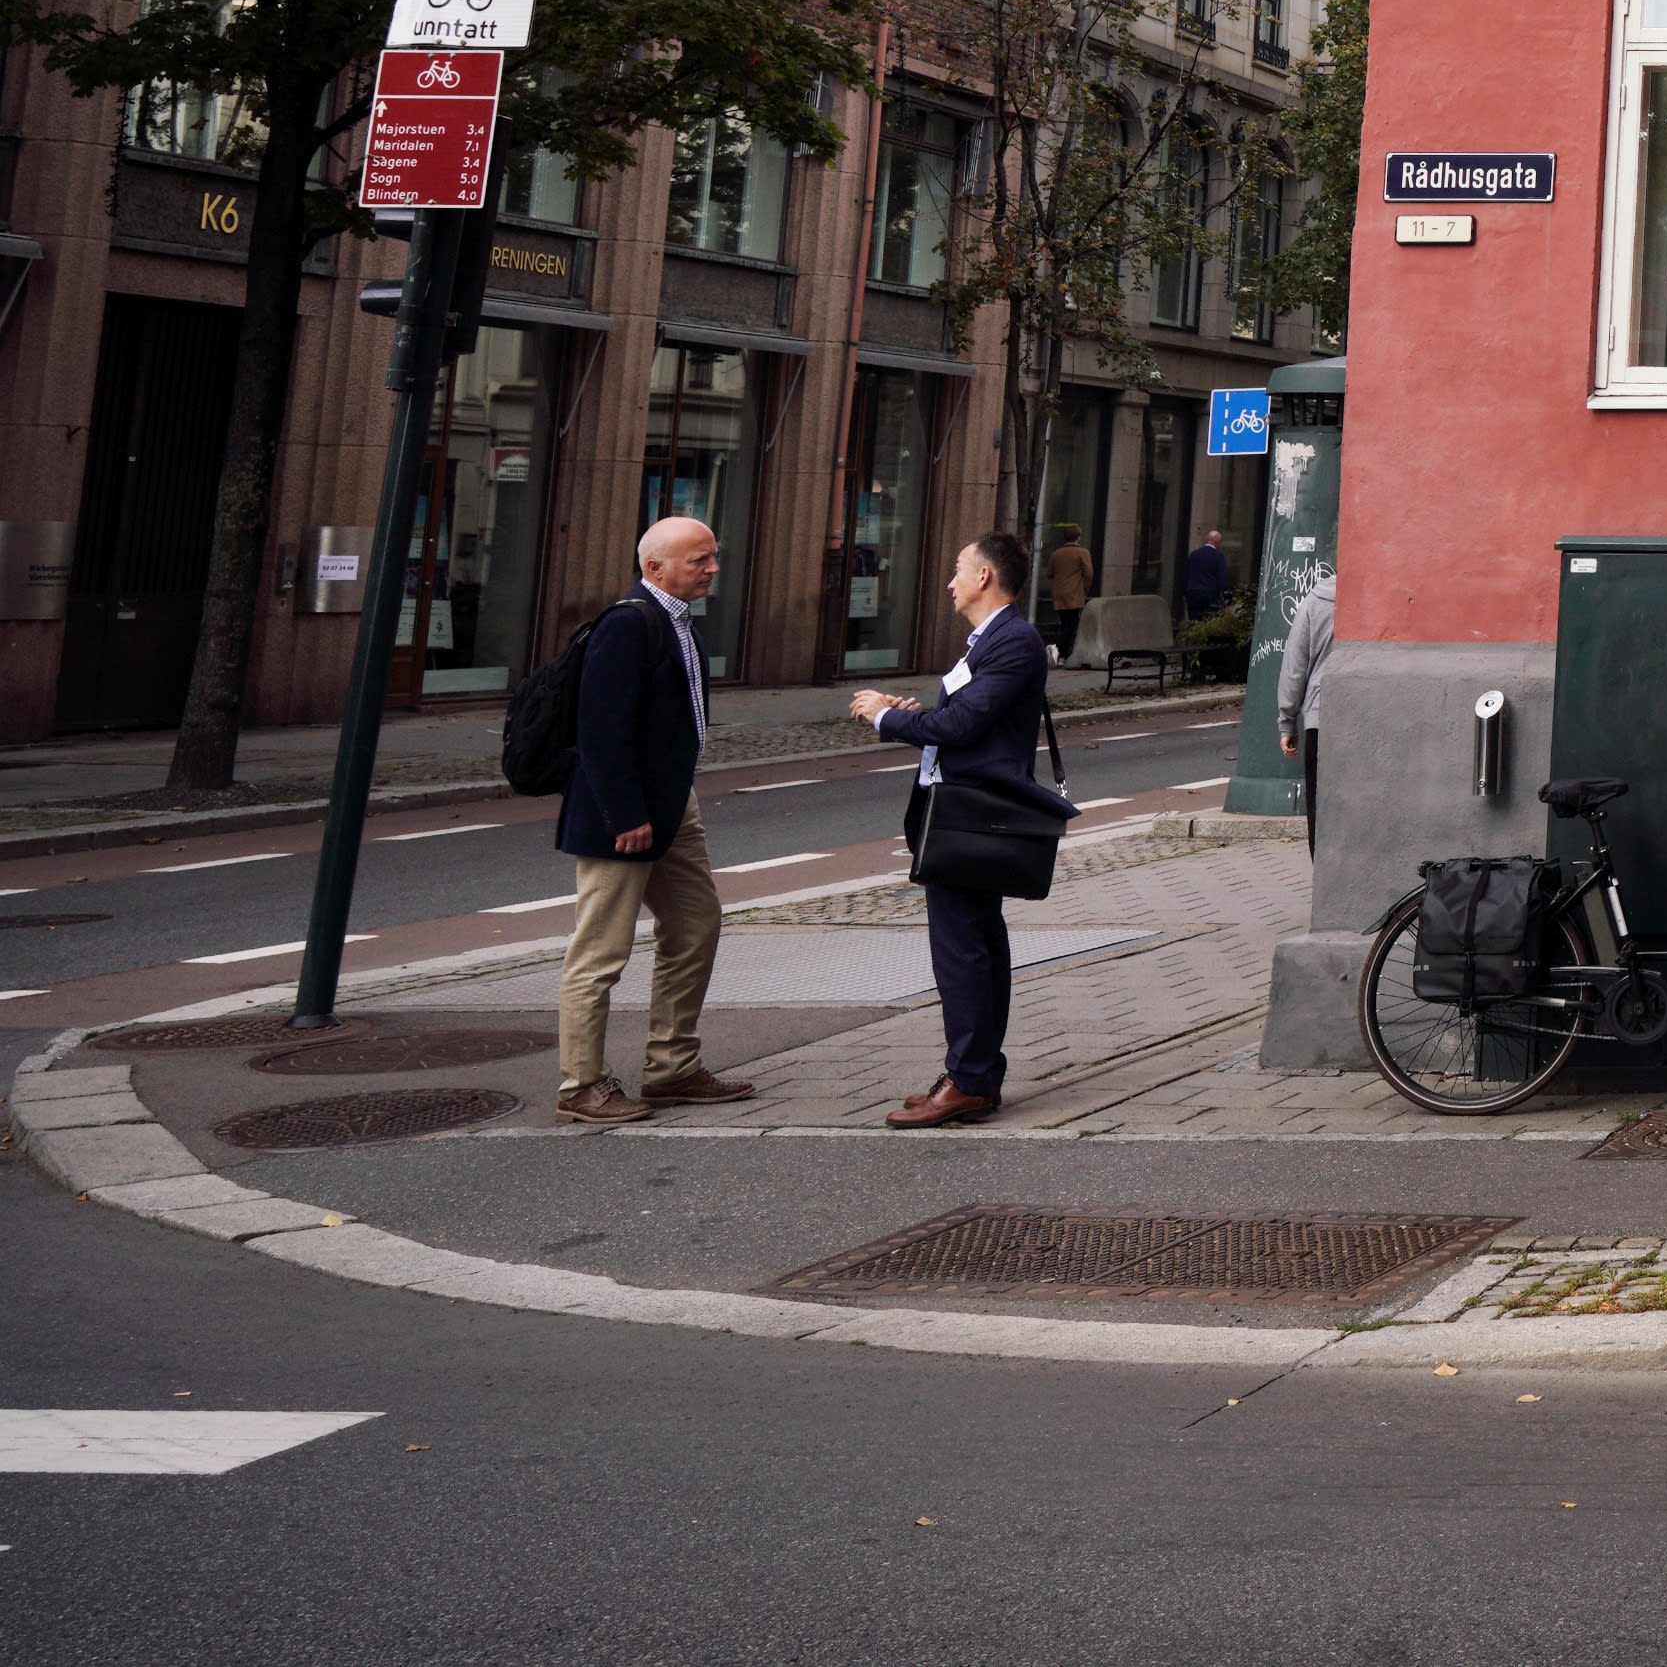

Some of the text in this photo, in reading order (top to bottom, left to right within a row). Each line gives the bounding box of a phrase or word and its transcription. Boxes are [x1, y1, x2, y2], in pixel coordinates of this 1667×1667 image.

[413, 18, 498, 40] unntatt
[376, 123, 446, 136] Majorstuen
[374, 140, 434, 152] Maridalen
[371, 156, 418, 169] Sagene
[370, 173, 401, 186] Sogn
[1401, 161, 1537, 196] Rådhusgata
[367, 189, 419, 201] Blindern
[200, 192, 240, 234] K6
[1412, 221, 1426, 237] 11
[1446, 221, 1456, 237] 7
[489, 245, 567, 277] RENINGEN
